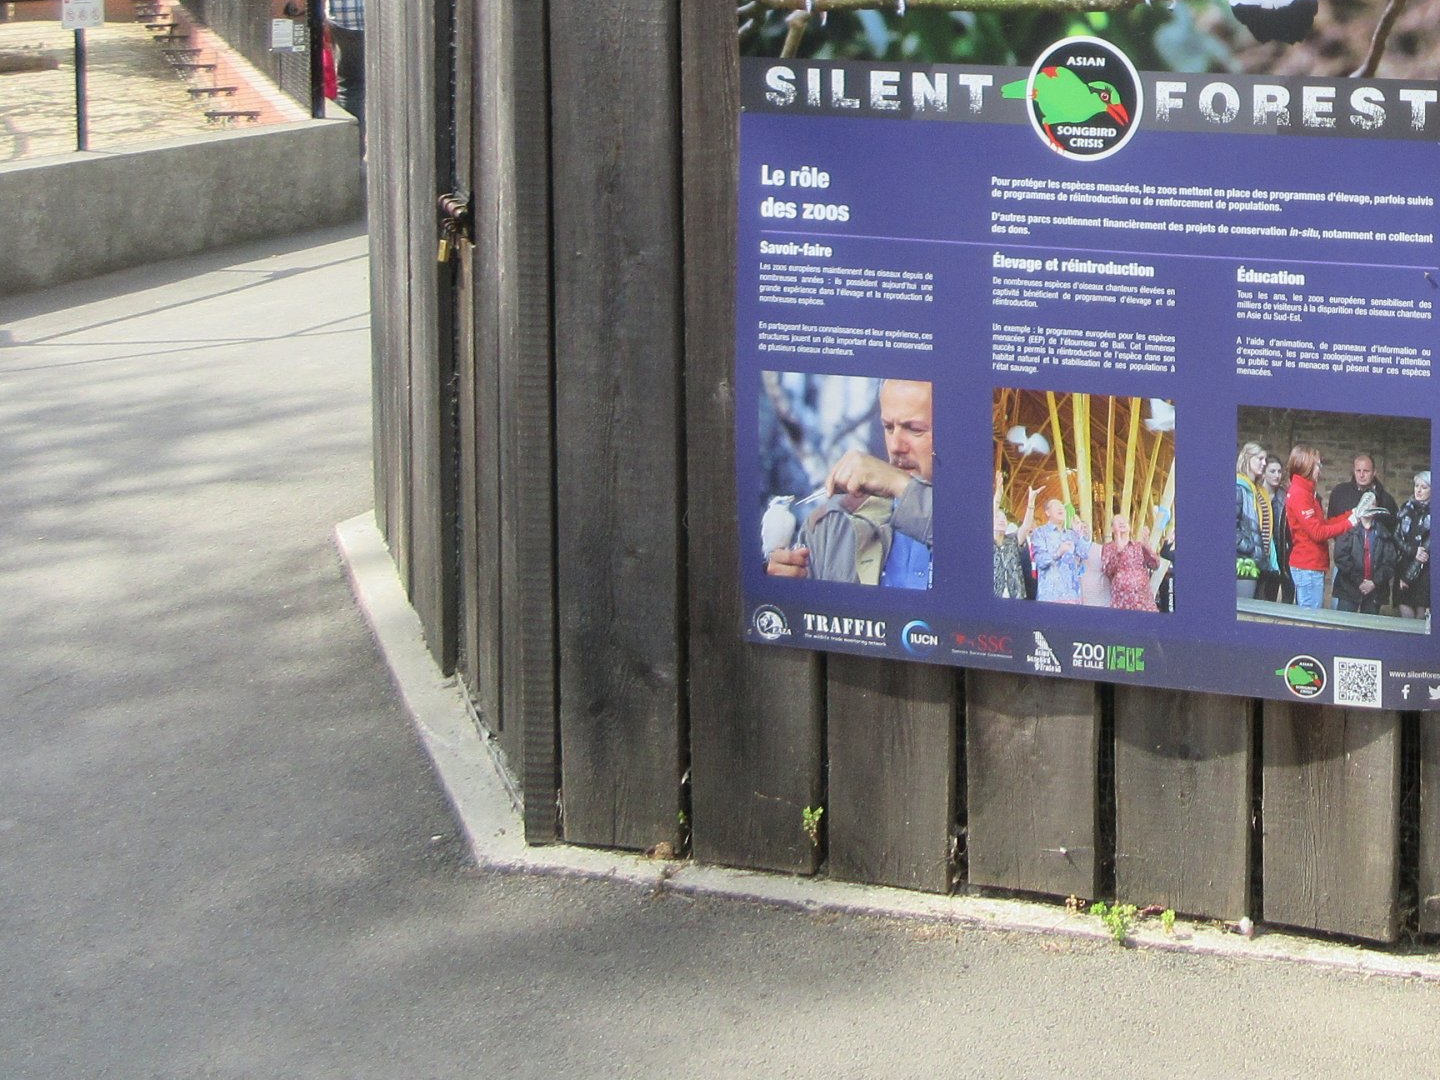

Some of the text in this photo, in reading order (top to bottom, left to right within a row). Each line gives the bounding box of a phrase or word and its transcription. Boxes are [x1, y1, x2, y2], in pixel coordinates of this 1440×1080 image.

[1066, 56, 1106, 67] ASIAN
[765, 66, 1438, 131] SILENT FOREST
[1057, 126, 1117, 137] SONGBIRD
[1069, 138, 1104, 148] CRISIS
[761, 164, 830, 188] Le rôle
[991, 176, 1010, 185] Pour
[1011, 176, 1046, 189] protéger
[1047, 178, 1060, 188] les
[1061, 178, 1095, 192] espèces
[1096, 180, 1141, 193] menacées,
[1142, 183, 1155, 193] les
[1157, 186, 1177, 194] zoos
[1178, 185, 1212, 195] mettent
[1226, 187, 1250, 199] place
[1252, 188, 1268, 198] des
[1269, 191, 1325, 203] programmes
[1374, 194, 1405, 207] parfois
[1407, 196, 1433, 206] suivis
[991, 188, 1002, 197] de
[1003, 190, 1055, 202] programmes
[1057, 191, 1067, 200] de
[1069, 191, 1128, 203] réintroduction
[1142, 195, 1153, 204] de
[1155, 196, 1213, 207] renforcement
[1215, 199, 1226, 208] de
[1228, 199, 1282, 213] populations.
[760, 196, 850, 221] des zoos
[992, 224, 1030, 236] des dons.
[1027, 215, 1050, 225] parcs
[1052, 214, 1101, 225] soutiennent
[1102, 216, 1166, 229] financièrement
[1168, 220, 1183, 229] des
[1185, 221, 1215, 233] projets
[1217, 222, 1228, 232] de
[1230, 223, 1287, 235] conservation
[1289, 226, 1320, 237] in-situ,
[1322, 227, 1373, 239] notamment
[1388, 231, 1432, 242] collectant
[760, 240, 832, 257] Savoir-faire
[992, 252, 1154, 277] Élevage et réintroduction
[1237, 265, 1305, 285] Éducation
[1238, 290, 1252, 298] Tous
[1258, 291, 1268, 299] les
[1292, 293, 1302, 301] les
[1329, 295, 1365, 306] européens
[1418, 301, 1431, 309] des
[1236, 300, 1261, 308] milliers
[1262, 301, 1271, 309] de
[1273, 302, 1302, 311] visiteurs
[1309, 304, 1316, 312] la
[1354, 307, 1367, 315] des
[1368, 308, 1395, 317] oiseaux
[1396, 309, 1431, 319] chanteurs
[1273, 312, 1302, 321] Sud-Est.
[1246, 336, 1264, 345] l'aide
[1332, 343, 1366, 352] panneaux
[1286, 348, 1296, 357] les
[1300, 351, 1319, 360] parcs
[1367, 353, 1392, 363] attirent
[1236, 356, 1245, 364] du
[1248, 356, 1268, 367] public
[1285, 359, 1295, 367] les
[1298, 361, 1329, 369] menaces
[1332, 362, 1343, 372] qui
[1346, 362, 1369, 373] pèsent
[1401, 365, 1430, 377] espèces
[1236, 366, 1272, 375] menacées.
[804, 613, 886, 639] TRAFFIC
[910, 633, 938, 646] IUCN
[978, 634, 1013, 654] SSC
[1073, 642, 1105, 660] ZOO
[1073, 659, 1104, 669] DE LILLE
